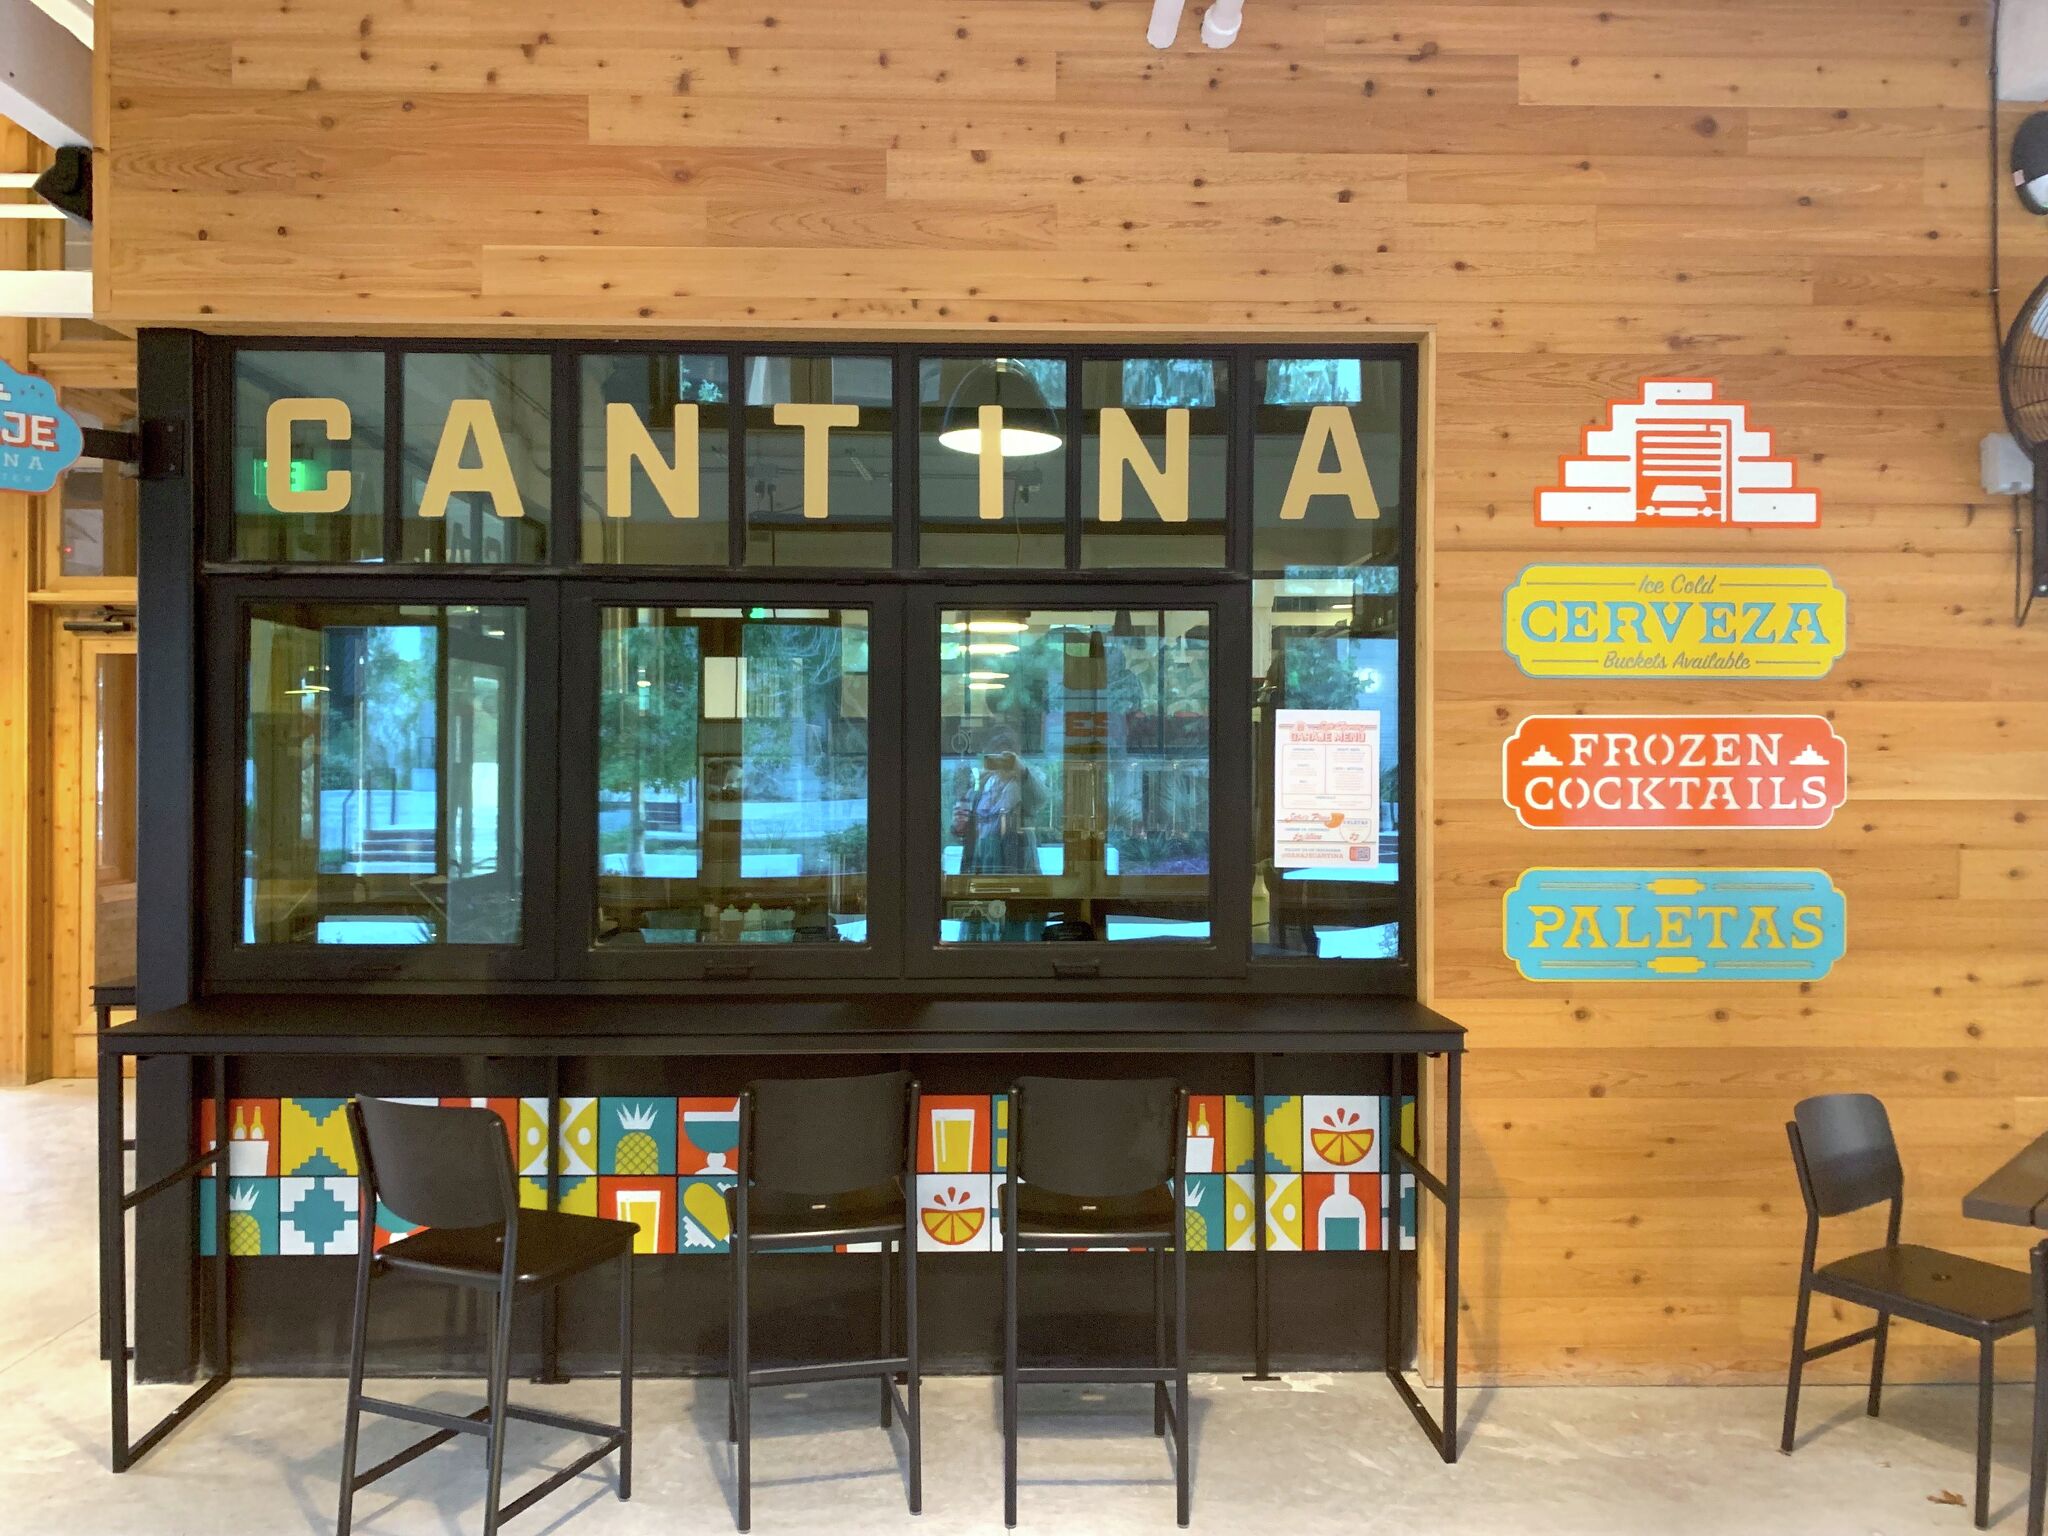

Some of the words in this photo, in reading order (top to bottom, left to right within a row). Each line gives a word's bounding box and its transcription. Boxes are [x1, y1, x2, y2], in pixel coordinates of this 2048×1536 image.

[264, 396, 1381, 523] CANTINA
[1638, 574, 1665, 594] Ice
[1671, 573, 1717, 594] Cold
[1521, 601, 1830, 645] CERVEZA
[1603, 650, 1667, 670] Buckets
[1672, 650, 1751, 670] Available
[1569, 732, 1784, 767] FROZEN
[1525, 776, 1828, 810] COCKTAILS
[1528, 905, 1825, 950] PALETAS
